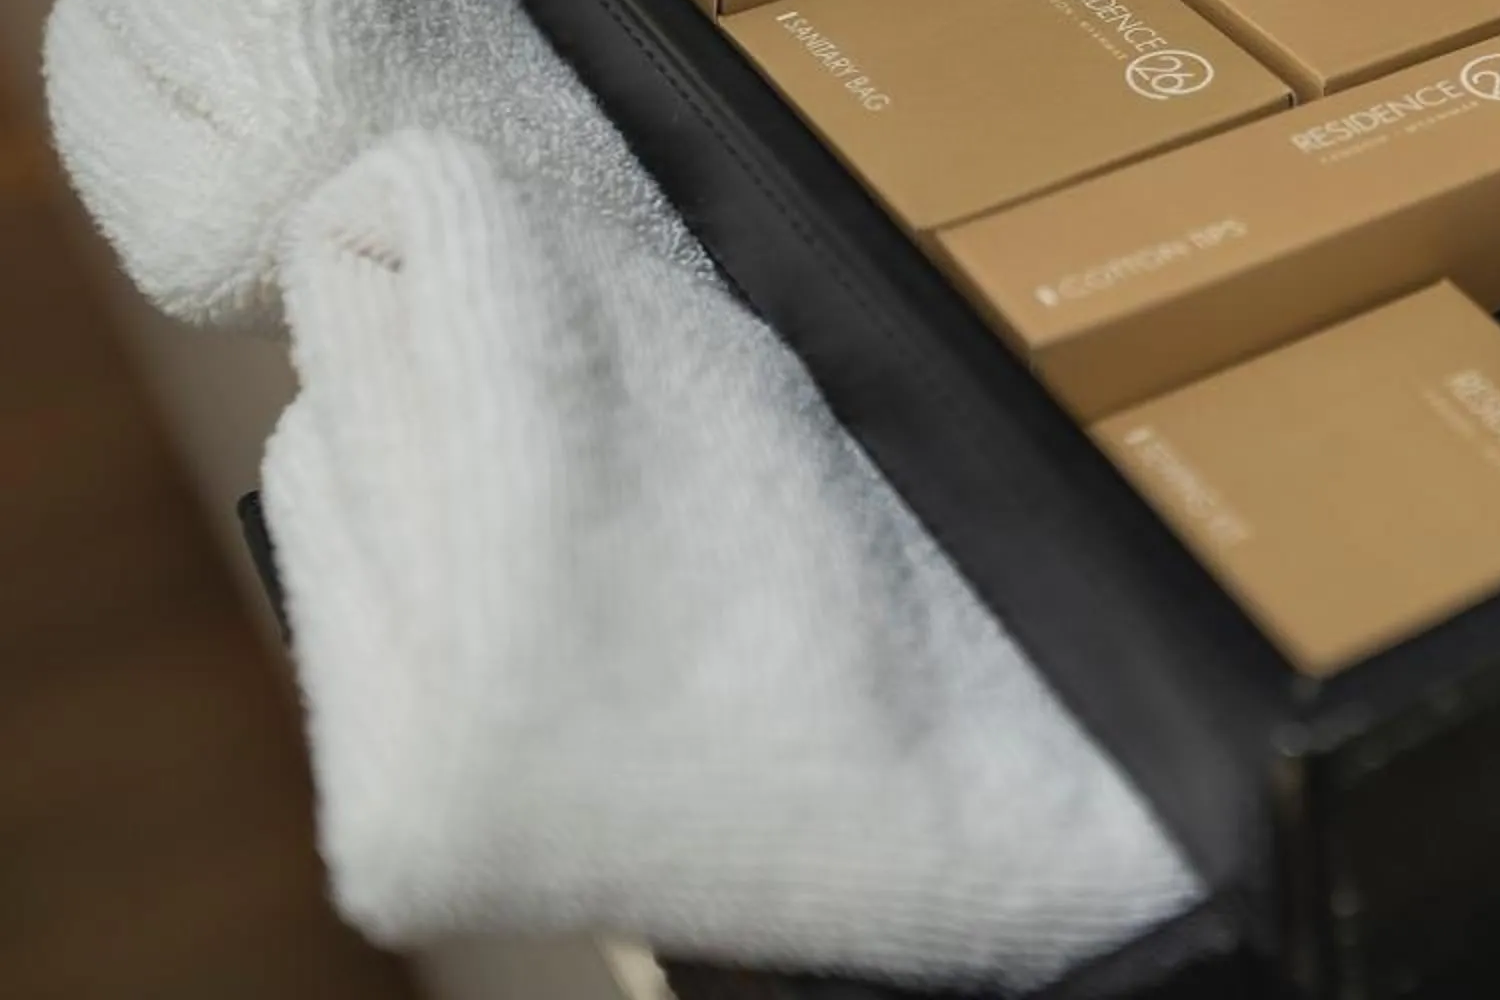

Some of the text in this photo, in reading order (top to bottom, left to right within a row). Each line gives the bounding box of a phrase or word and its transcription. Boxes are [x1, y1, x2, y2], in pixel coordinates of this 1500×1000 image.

[783, 18, 891, 111] SANITARY BAG
[1125, 50, 1214, 100] 26
[1290, 79, 1465, 153] RESIDENCE
